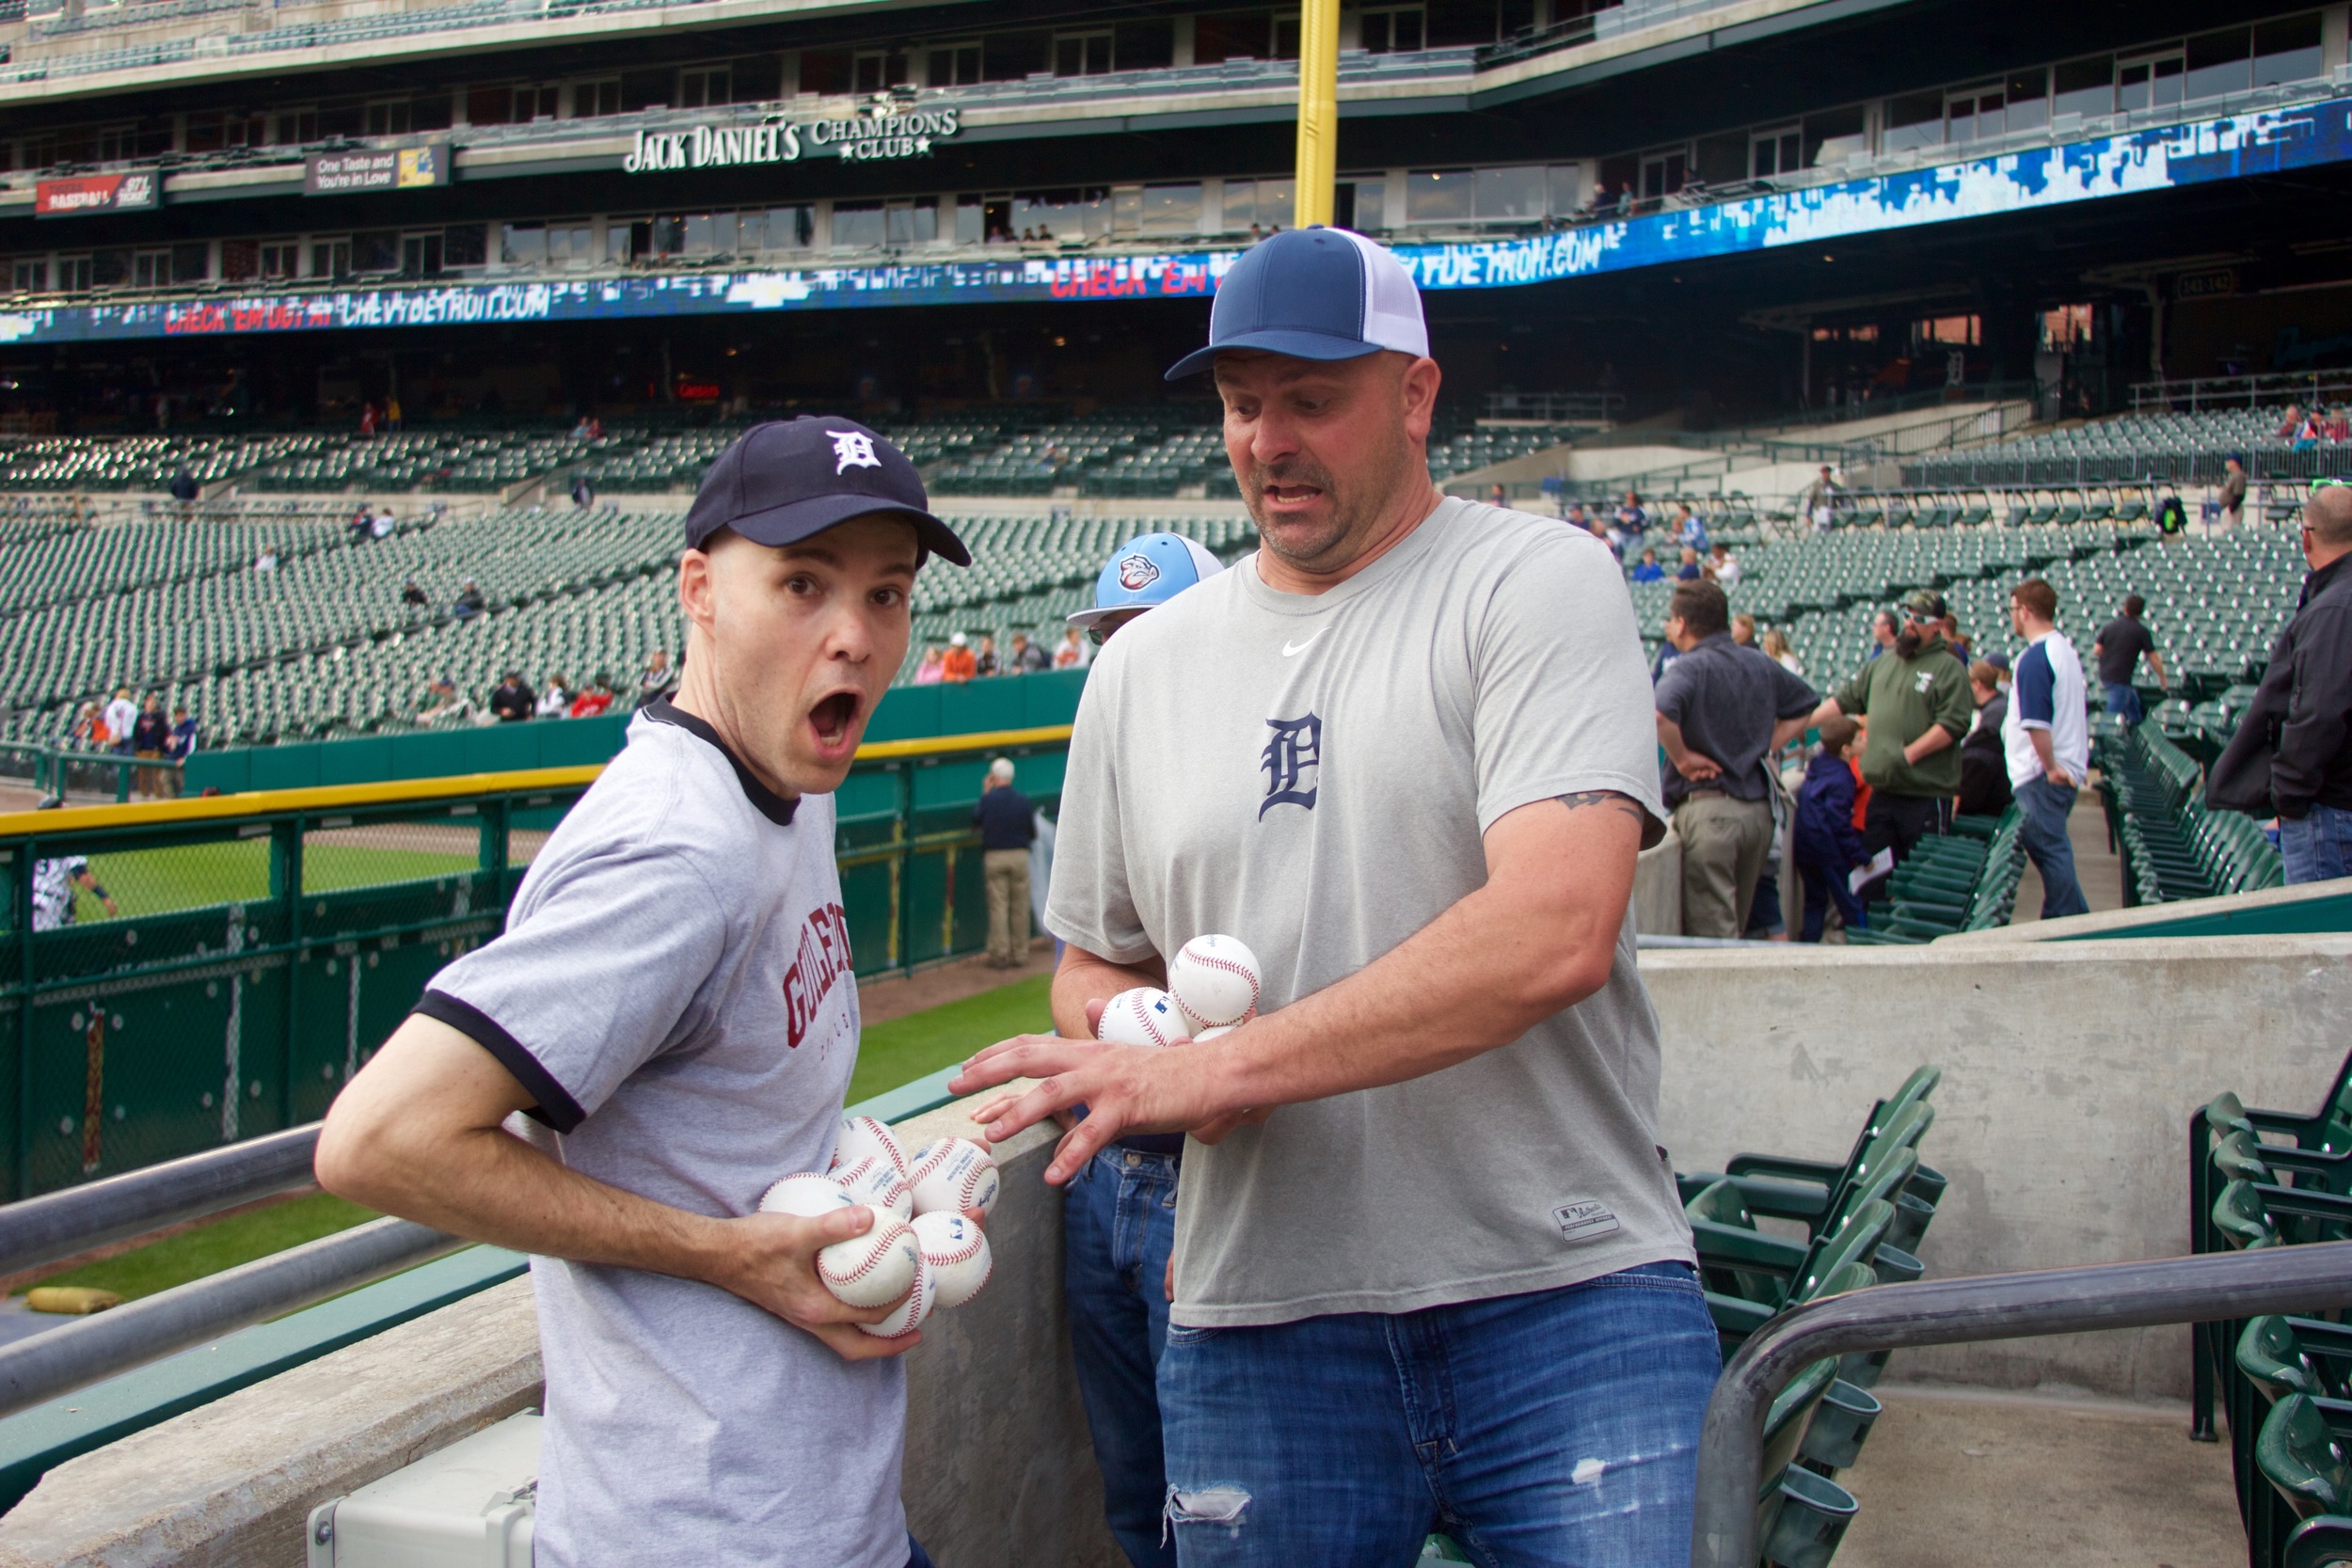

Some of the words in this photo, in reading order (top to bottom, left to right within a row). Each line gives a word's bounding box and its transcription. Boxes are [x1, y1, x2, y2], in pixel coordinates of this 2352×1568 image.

[812, 109, 959, 144] CHAMPIONS
[318, 159, 340, 174] One
[342, 157, 371, 172] Taste
[373, 151, 394, 168] and
[624, 130, 689, 173] JACK
[692, 121, 800, 167] DANIEL'S
[857, 136, 914, 160] CLUB
[317, 173, 350, 188] You're
[353, 171, 363, 185] in
[365, 170, 391, 185] Love
[1051, 261, 1147, 297] CHECK
[165, 304, 227, 335] CHECK
[340, 286, 551, 326] CHEVYDETROIT.COM
